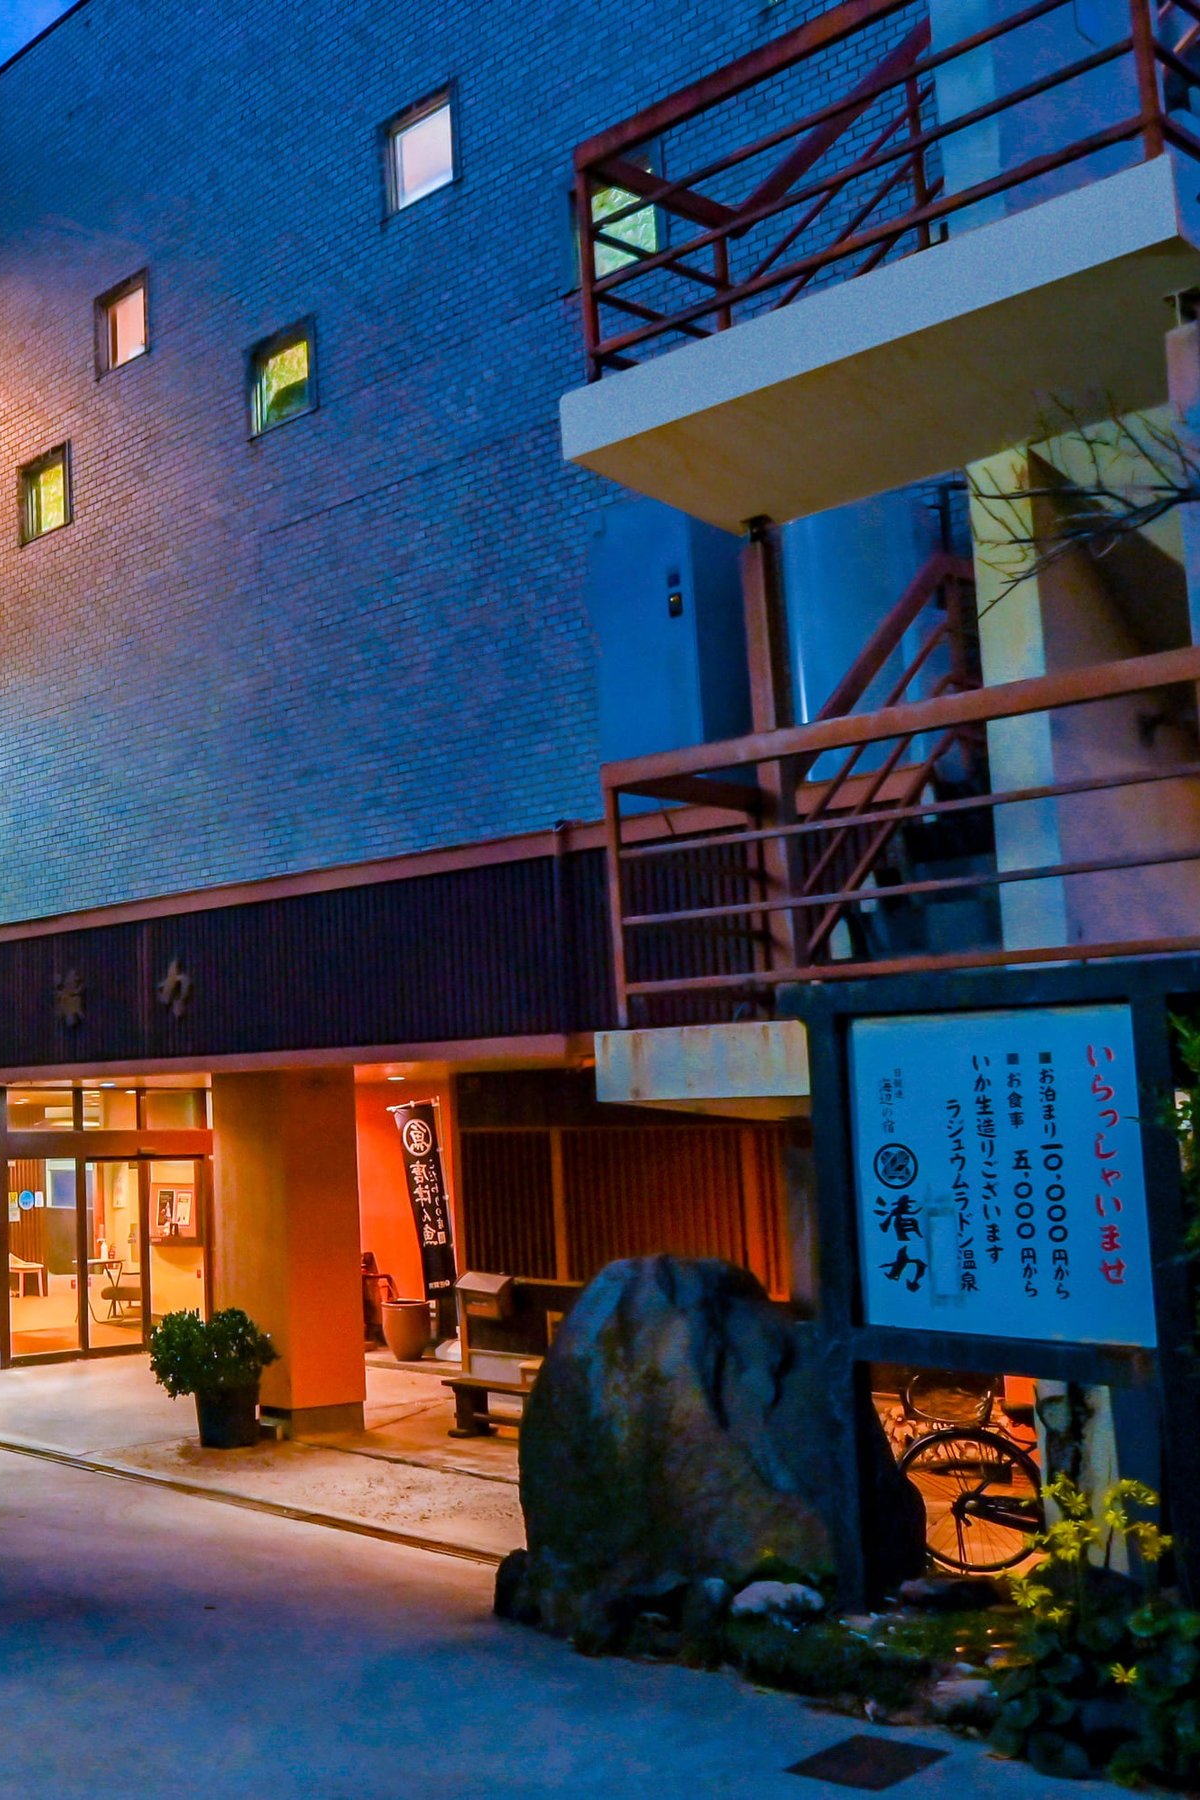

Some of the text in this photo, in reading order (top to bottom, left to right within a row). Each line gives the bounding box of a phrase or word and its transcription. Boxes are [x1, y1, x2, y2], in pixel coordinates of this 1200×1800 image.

[873, 1194, 929, 1293] 清力
[946, 1099, 980, 1292] ラジュウムラドン温泉
[972, 1054, 1004, 1264] いか生造りございます
[1086, 1044, 1126, 1286] いらっしゃいませ
